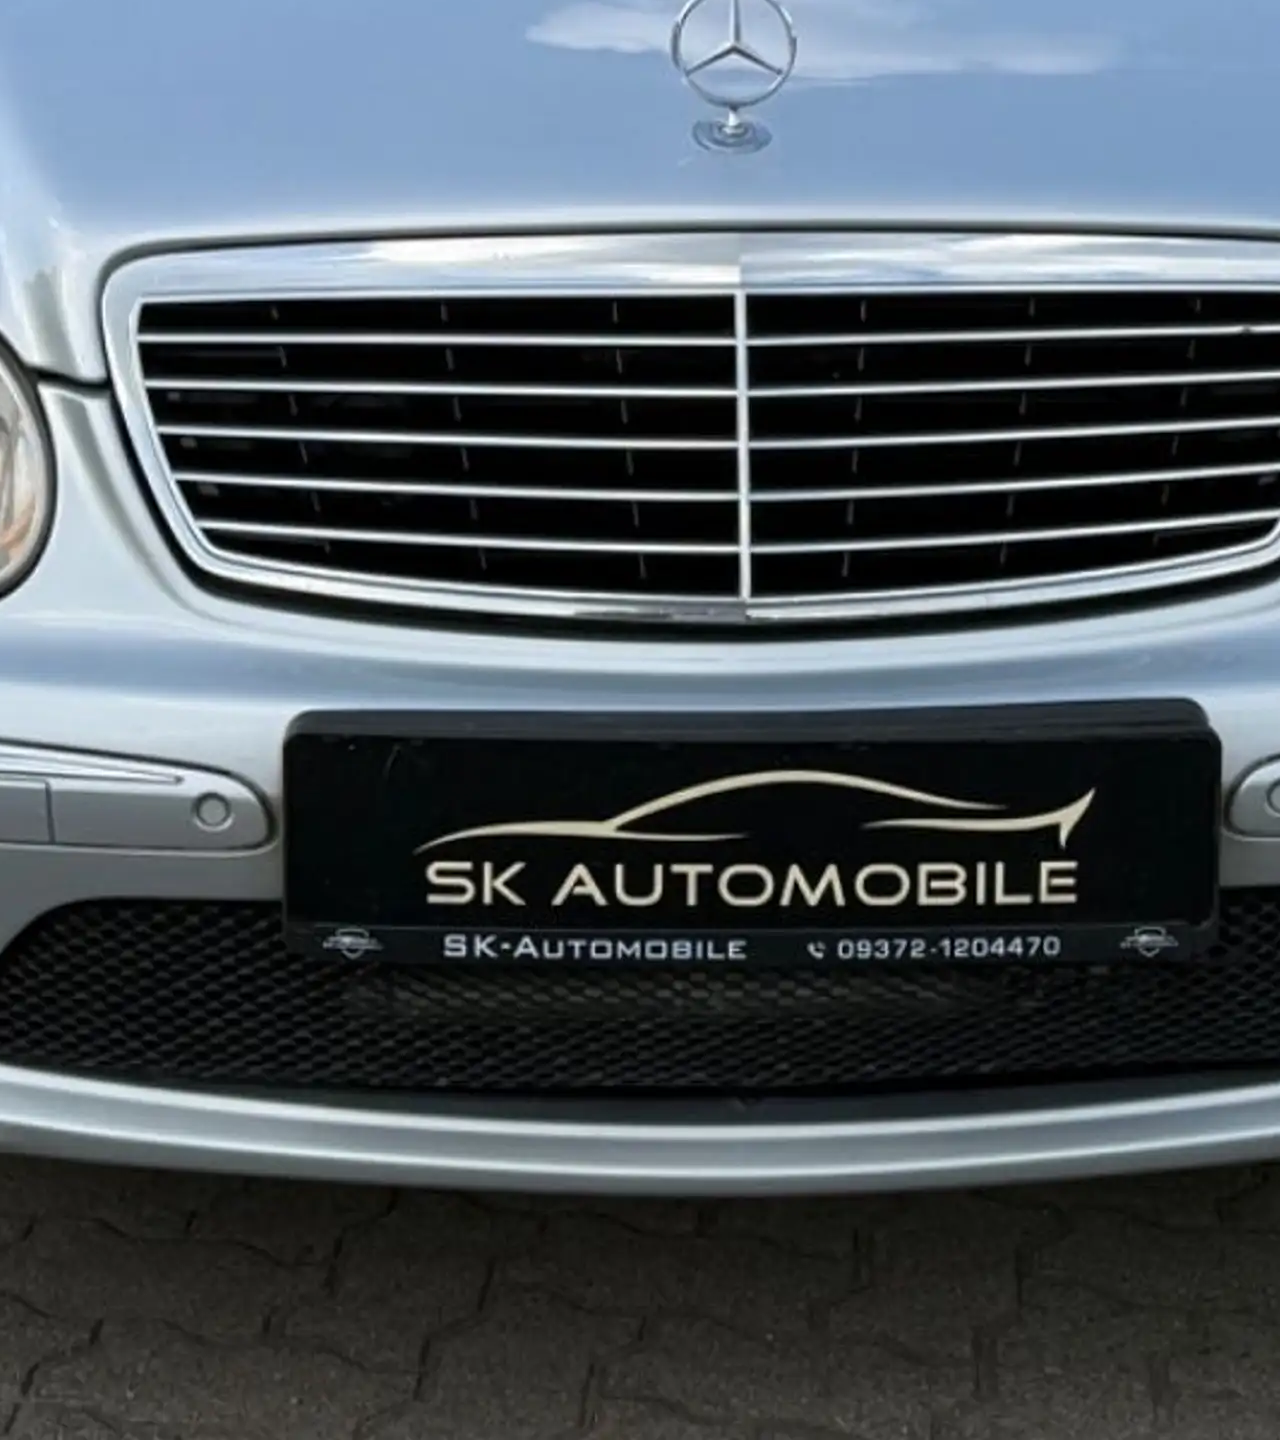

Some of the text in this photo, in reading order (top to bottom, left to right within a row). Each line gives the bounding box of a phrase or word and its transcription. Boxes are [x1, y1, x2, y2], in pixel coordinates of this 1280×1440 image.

[425, 860, 1079, 907] SK AUTOMOBILE
[443, 934, 1062, 960] SK-AUTOMOBILE 09372-1204470
